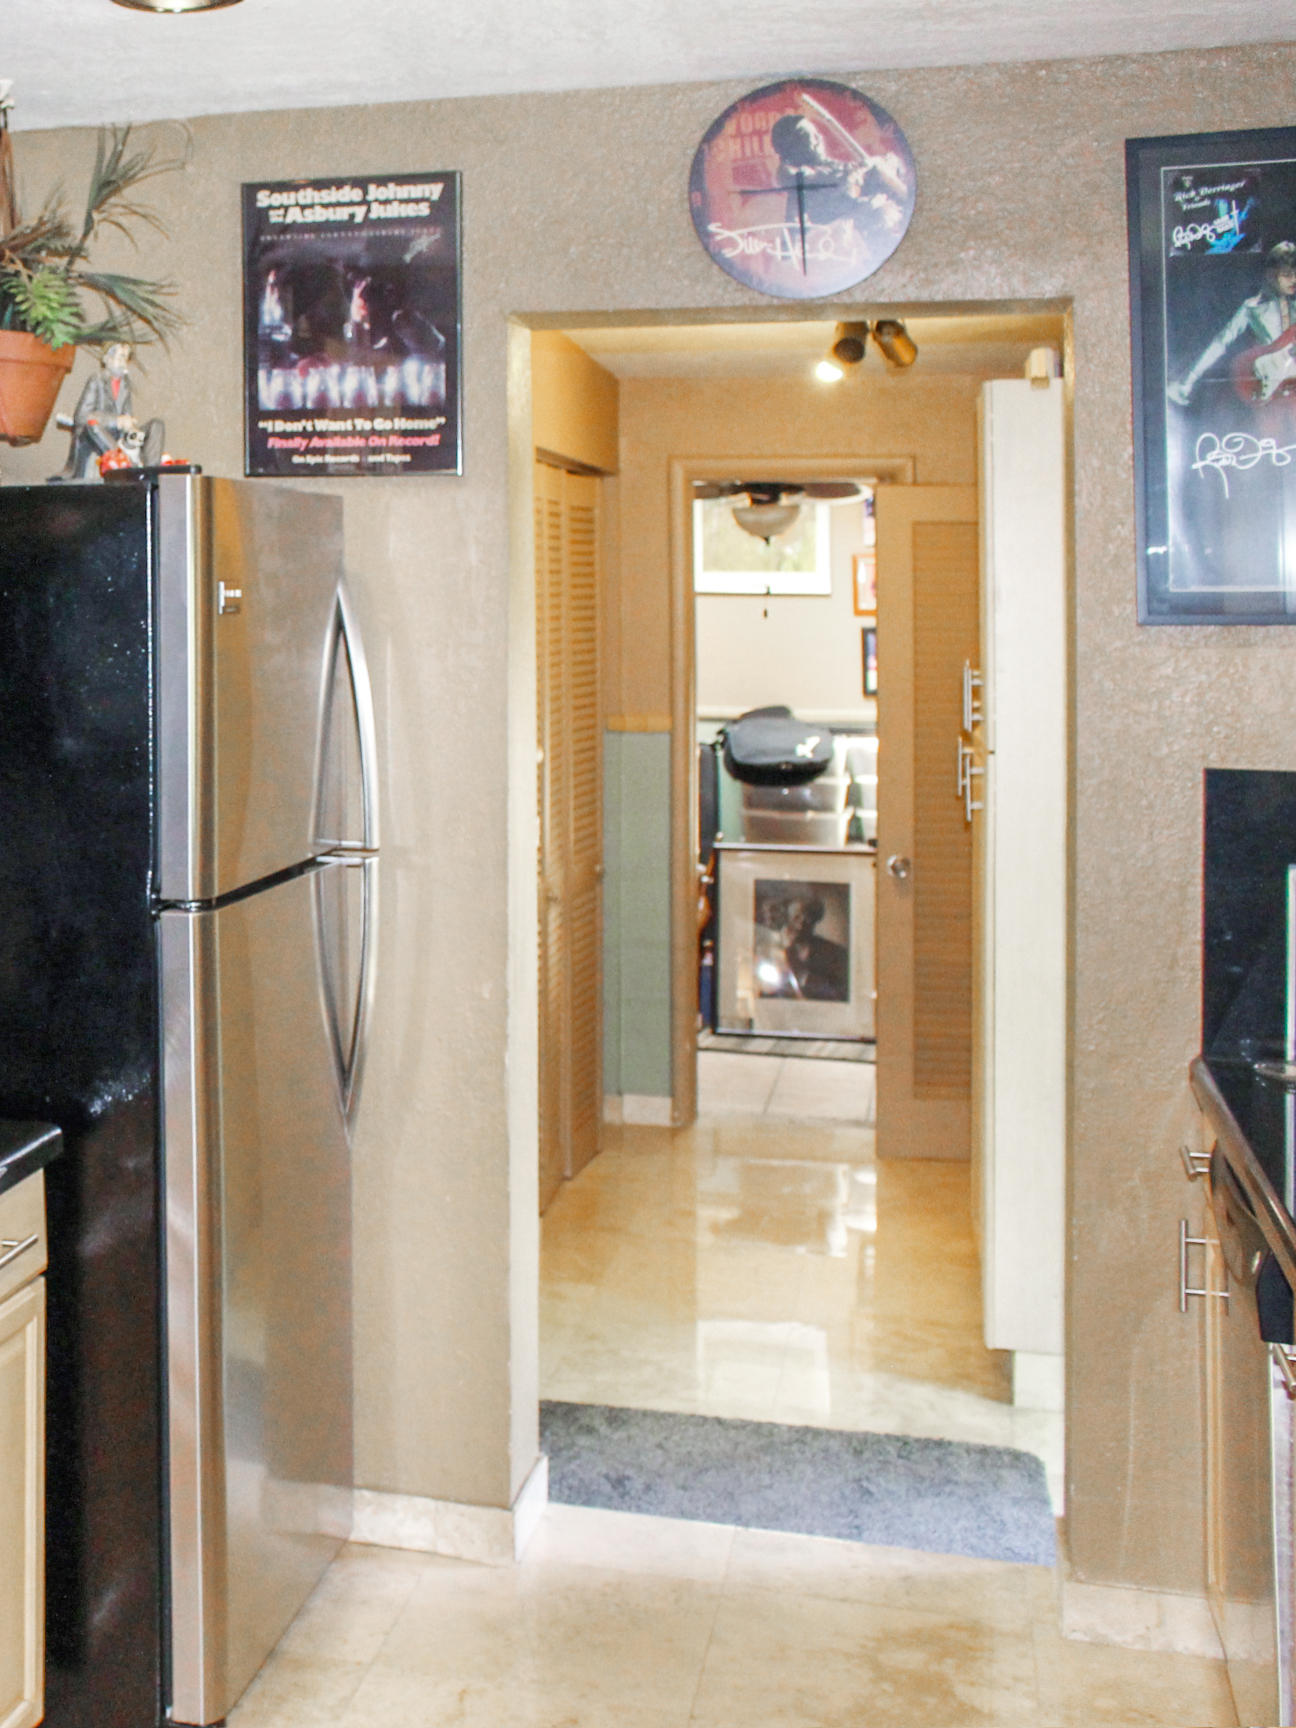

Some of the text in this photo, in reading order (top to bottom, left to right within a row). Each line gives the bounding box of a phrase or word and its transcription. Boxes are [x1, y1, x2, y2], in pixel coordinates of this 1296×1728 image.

[256, 182, 444, 208] Southside Johnny
[285, 204, 368, 224] Asbury
[368, 200, 431, 219] Jukes
[274, 418, 313, 432] Don't
[314, 418, 353, 432] Want
[354, 417, 373, 431] To
[373, 417, 393, 431] Go
[267, 436, 309, 452] Finally
[309, 435, 366, 448] Available
[367, 434, 387, 447] On
